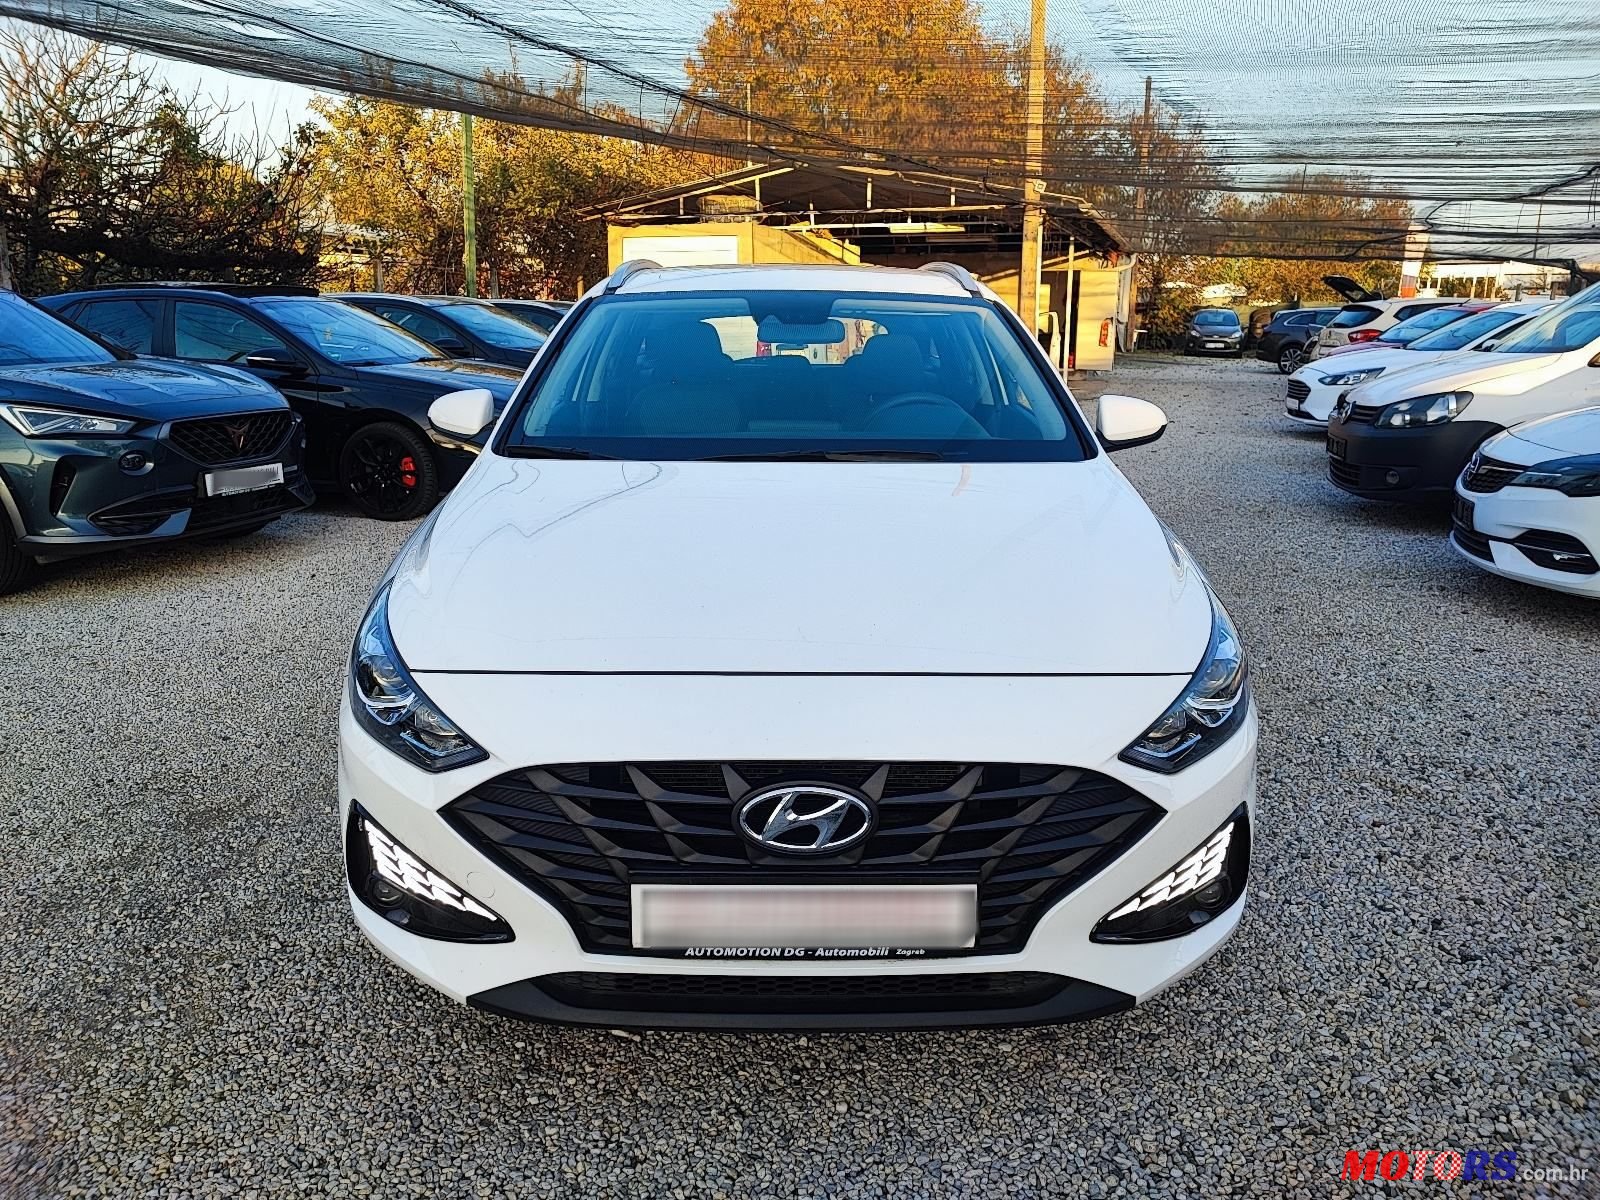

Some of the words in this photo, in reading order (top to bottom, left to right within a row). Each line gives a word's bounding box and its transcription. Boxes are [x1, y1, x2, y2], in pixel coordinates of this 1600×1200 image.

[684, 946, 782, 957] AUTOMOTION
[783, 946, 805, 957] DG
[814, 946, 890, 957] Automobili
[895, 948, 926, 957] Zagreb
